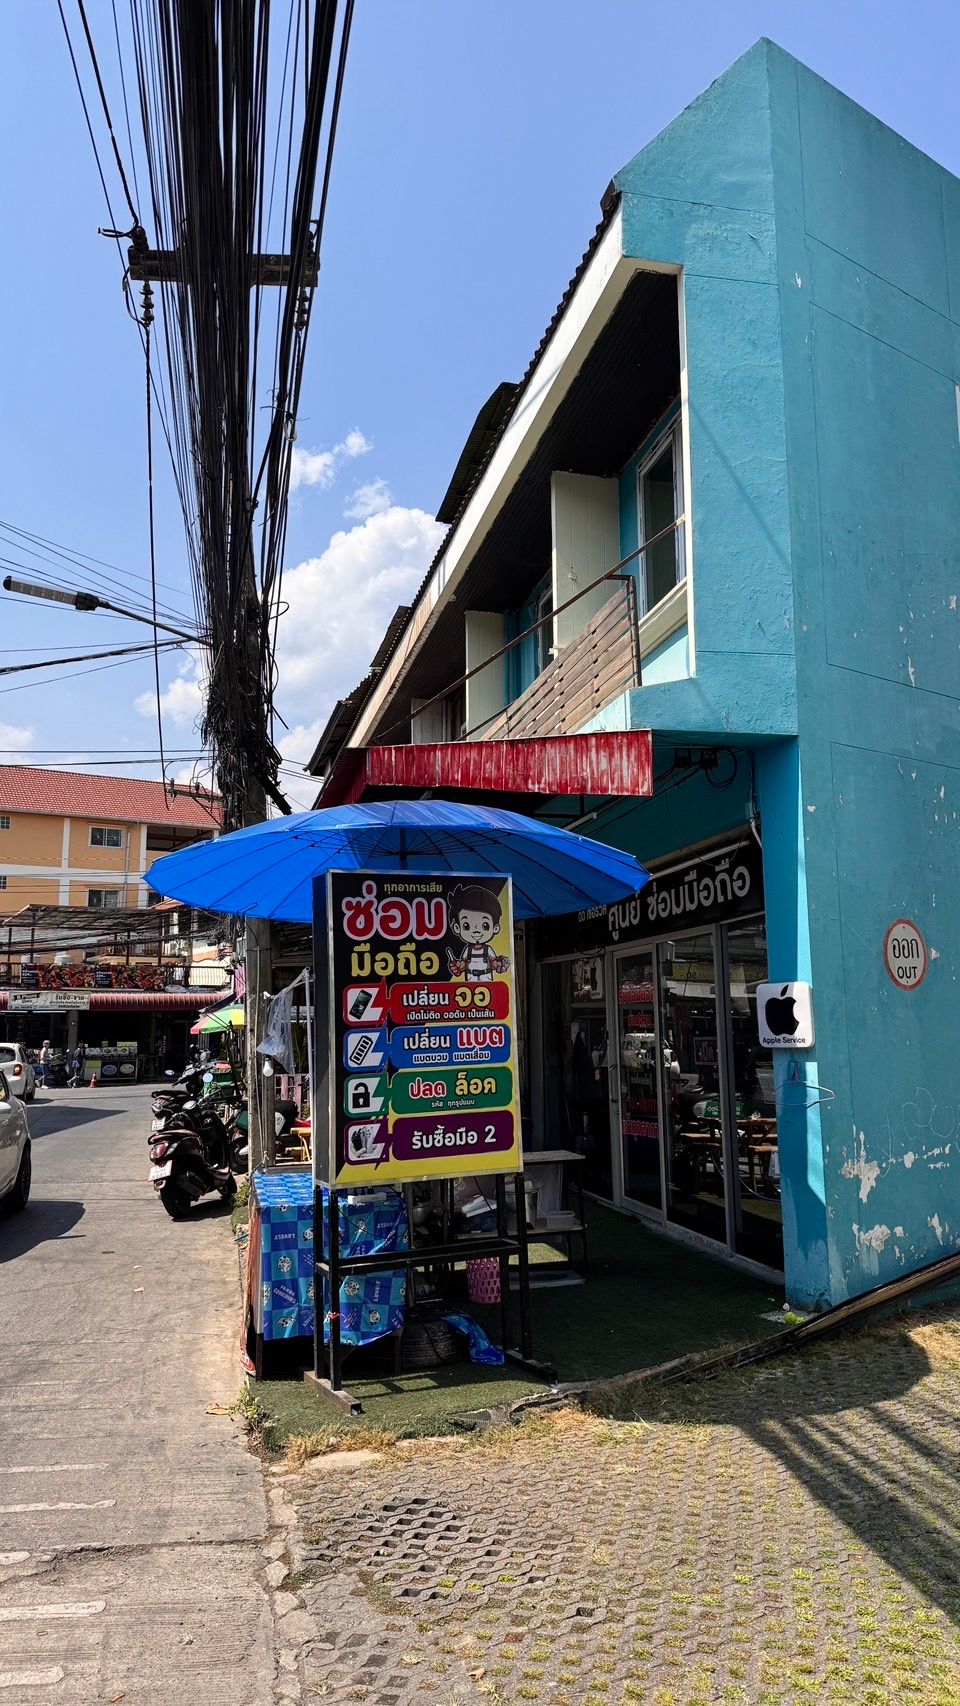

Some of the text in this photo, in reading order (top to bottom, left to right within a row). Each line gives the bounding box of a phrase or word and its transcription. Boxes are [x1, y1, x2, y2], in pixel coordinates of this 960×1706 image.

[383, 882, 443, 894] ทุกอาการเสีย
[648, 859, 751, 921] ซ่อมมือถือ
[342, 880, 447, 941] ซ่อม
[350, 942, 440, 977] มือถือ
[891, 938, 919, 959] ออก
[897, 966, 917, 979] OUT
[402, 984, 492, 1008] เปลี่ยน จอ
[407, 1006, 495, 1021] เปิดไม่ติด จอดับ เป็นเส้น
[403, 1026, 505, 1050] เปลี่ยน แบต
[762, 1036, 806, 1045] Apple Service
[413, 1047, 491, 1063] แบตบวม แบตเสื่อม
[409, 1071, 497, 1099] ปลด ล็อค
[411, 1125, 497, 1150] รับซื้อมือ 2
